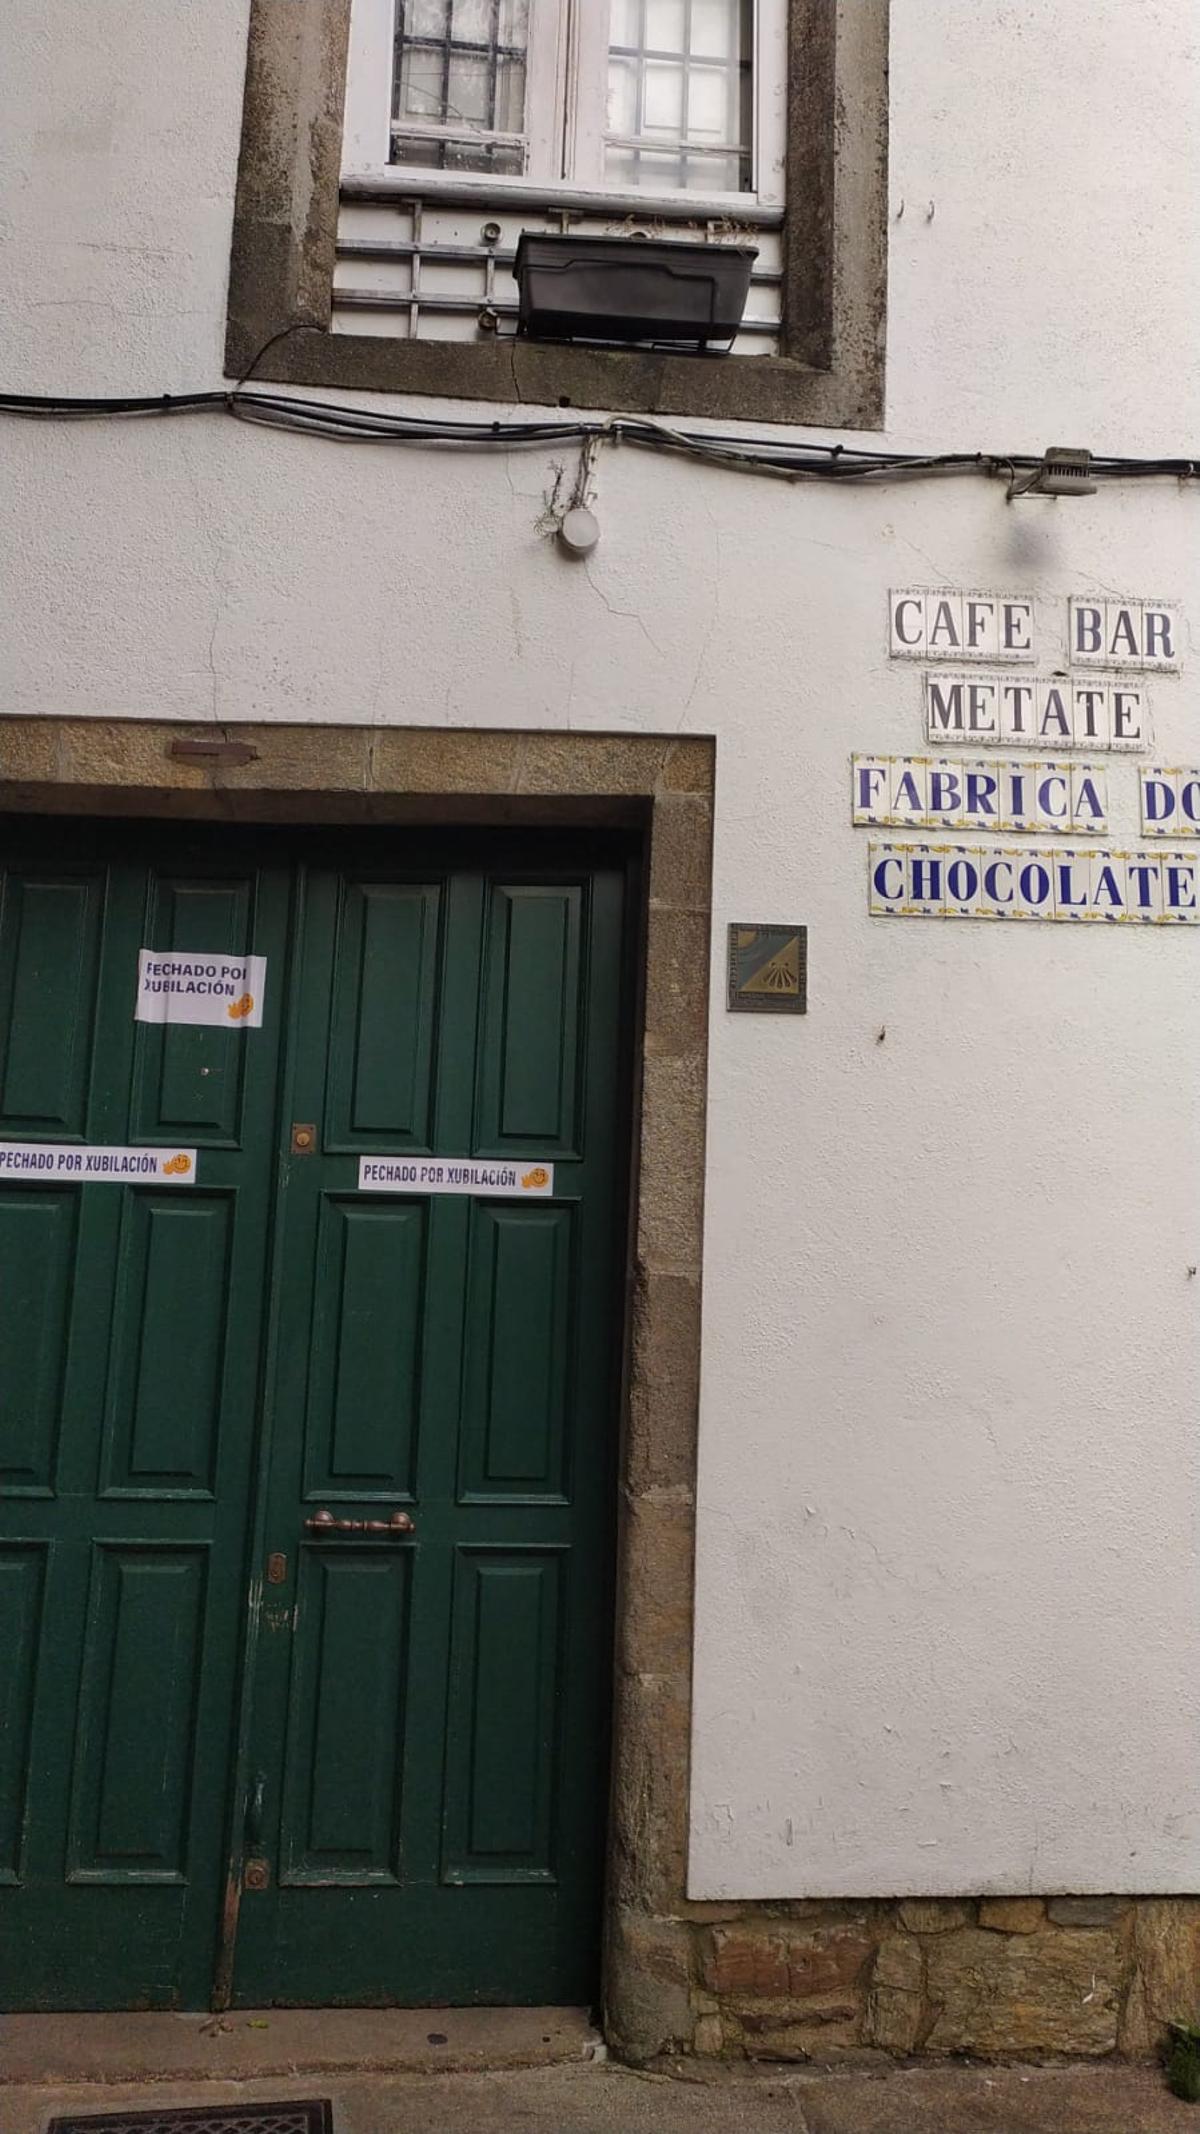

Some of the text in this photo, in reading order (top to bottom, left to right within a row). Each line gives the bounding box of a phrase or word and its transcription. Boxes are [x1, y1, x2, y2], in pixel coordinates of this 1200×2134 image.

[894, 599, 1175, 658] CAFE BAR
[929, 683, 1142, 739] METATE
[857, 768, 1104, 818] FABRICA
[873, 858, 1196, 908] CHOCOLATE
[57, 1154, 82, 1171] POR
[85, 1153, 157, 1173] XUBILACIÓN
[364, 1164, 516, 1186] PECHADO POR XUBILACIÓN
